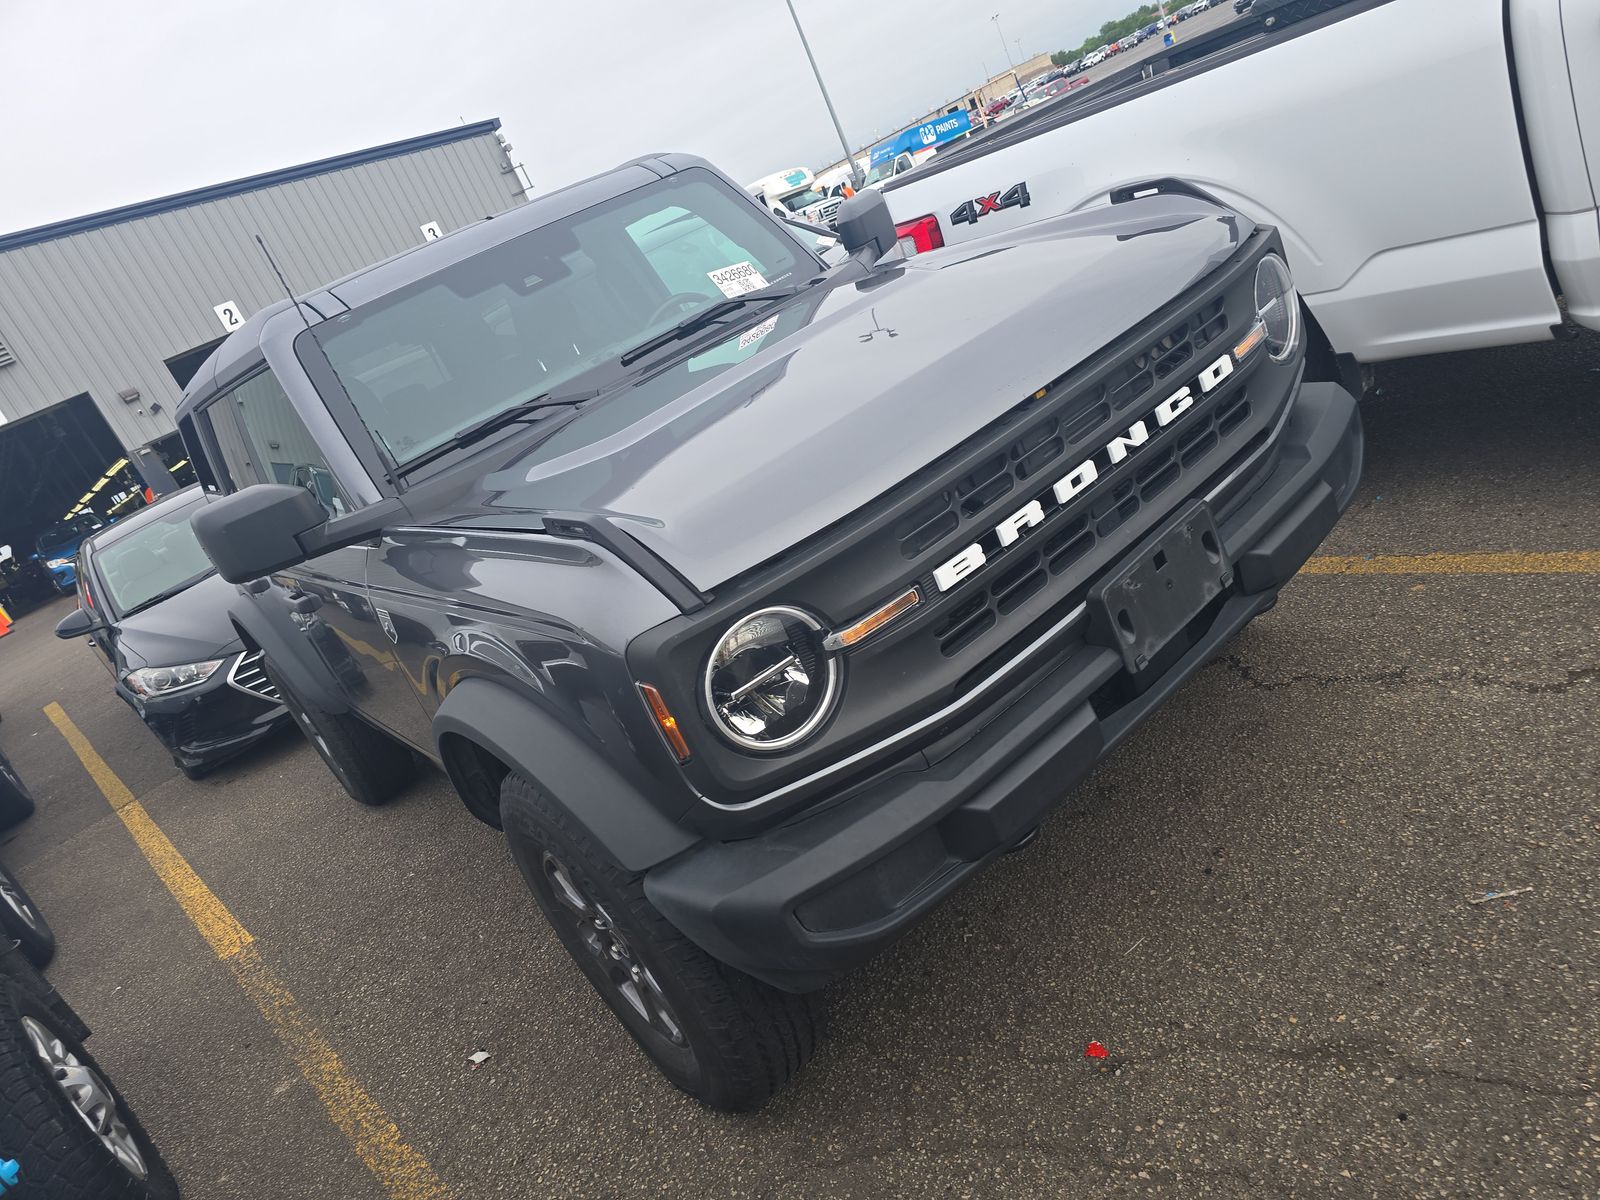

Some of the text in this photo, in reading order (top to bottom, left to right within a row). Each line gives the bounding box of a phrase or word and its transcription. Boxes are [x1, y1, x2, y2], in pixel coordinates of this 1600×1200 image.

[936, 118, 959, 135] PAINTS
[712, 264, 757, 285] 3426680
[223, 308, 239, 326] 2
[932, 354, 1234, 592] BRONCO
